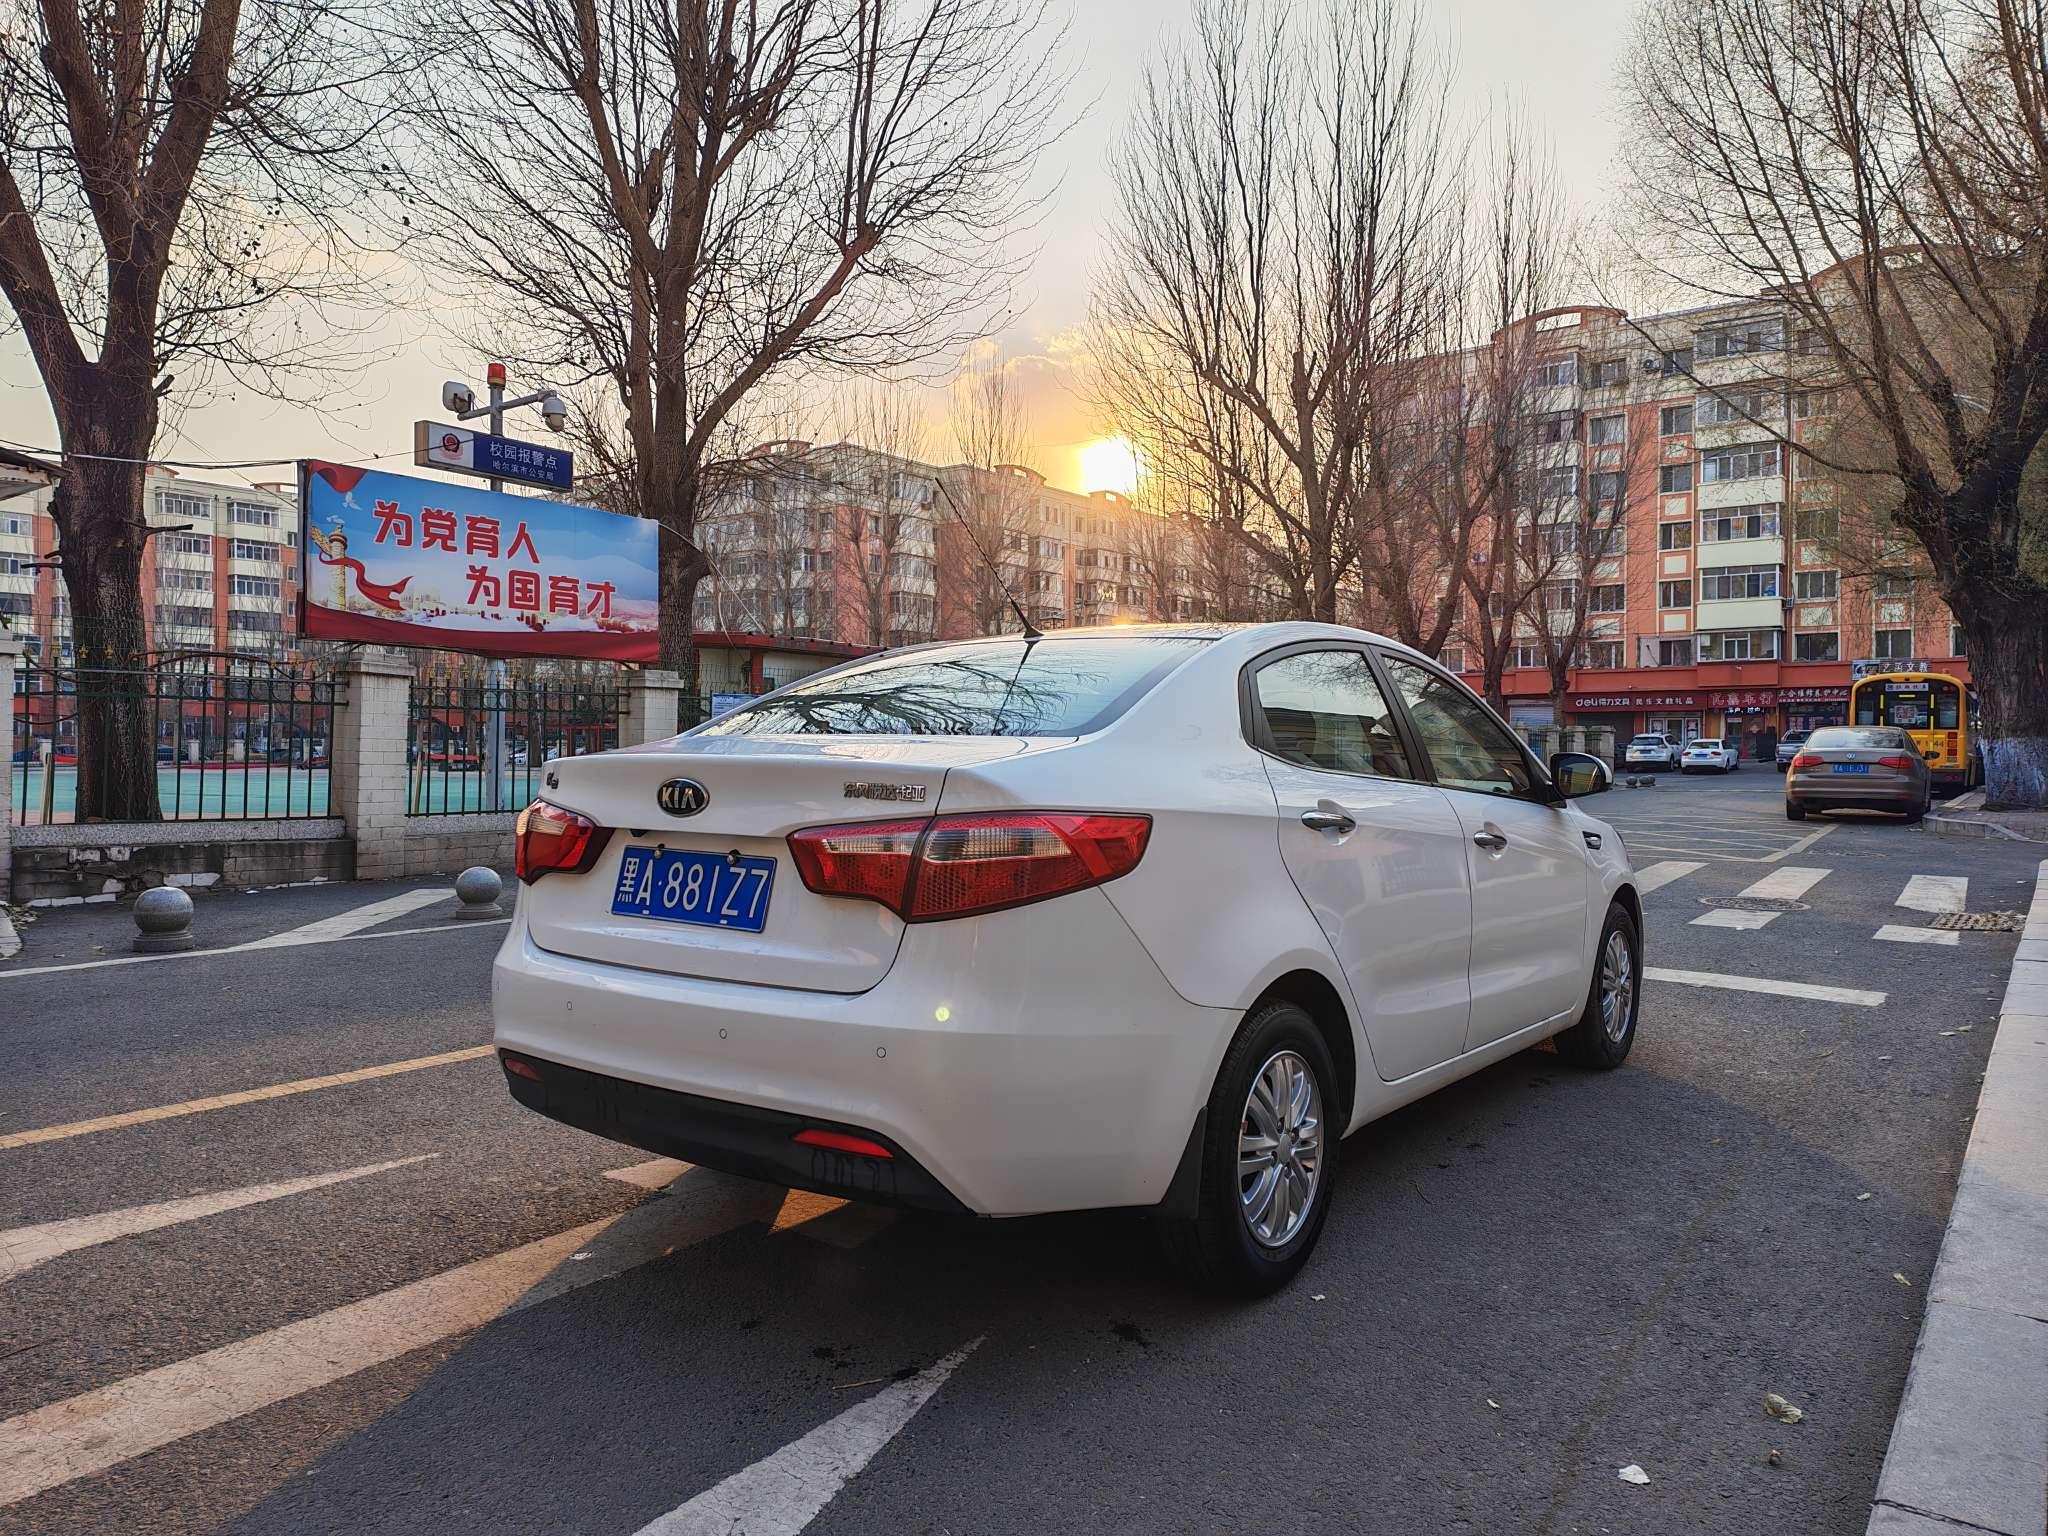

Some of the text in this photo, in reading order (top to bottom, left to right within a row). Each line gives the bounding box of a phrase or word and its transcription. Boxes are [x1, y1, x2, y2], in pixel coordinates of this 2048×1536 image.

[490, 441, 558, 471] 校园报警点
[492, 459, 554, 481] 哈尔滨市公安局
[373, 499, 540, 564] 为党育人
[465, 564, 617, 619] 为国育才
[660, 785, 697, 810] KIA
